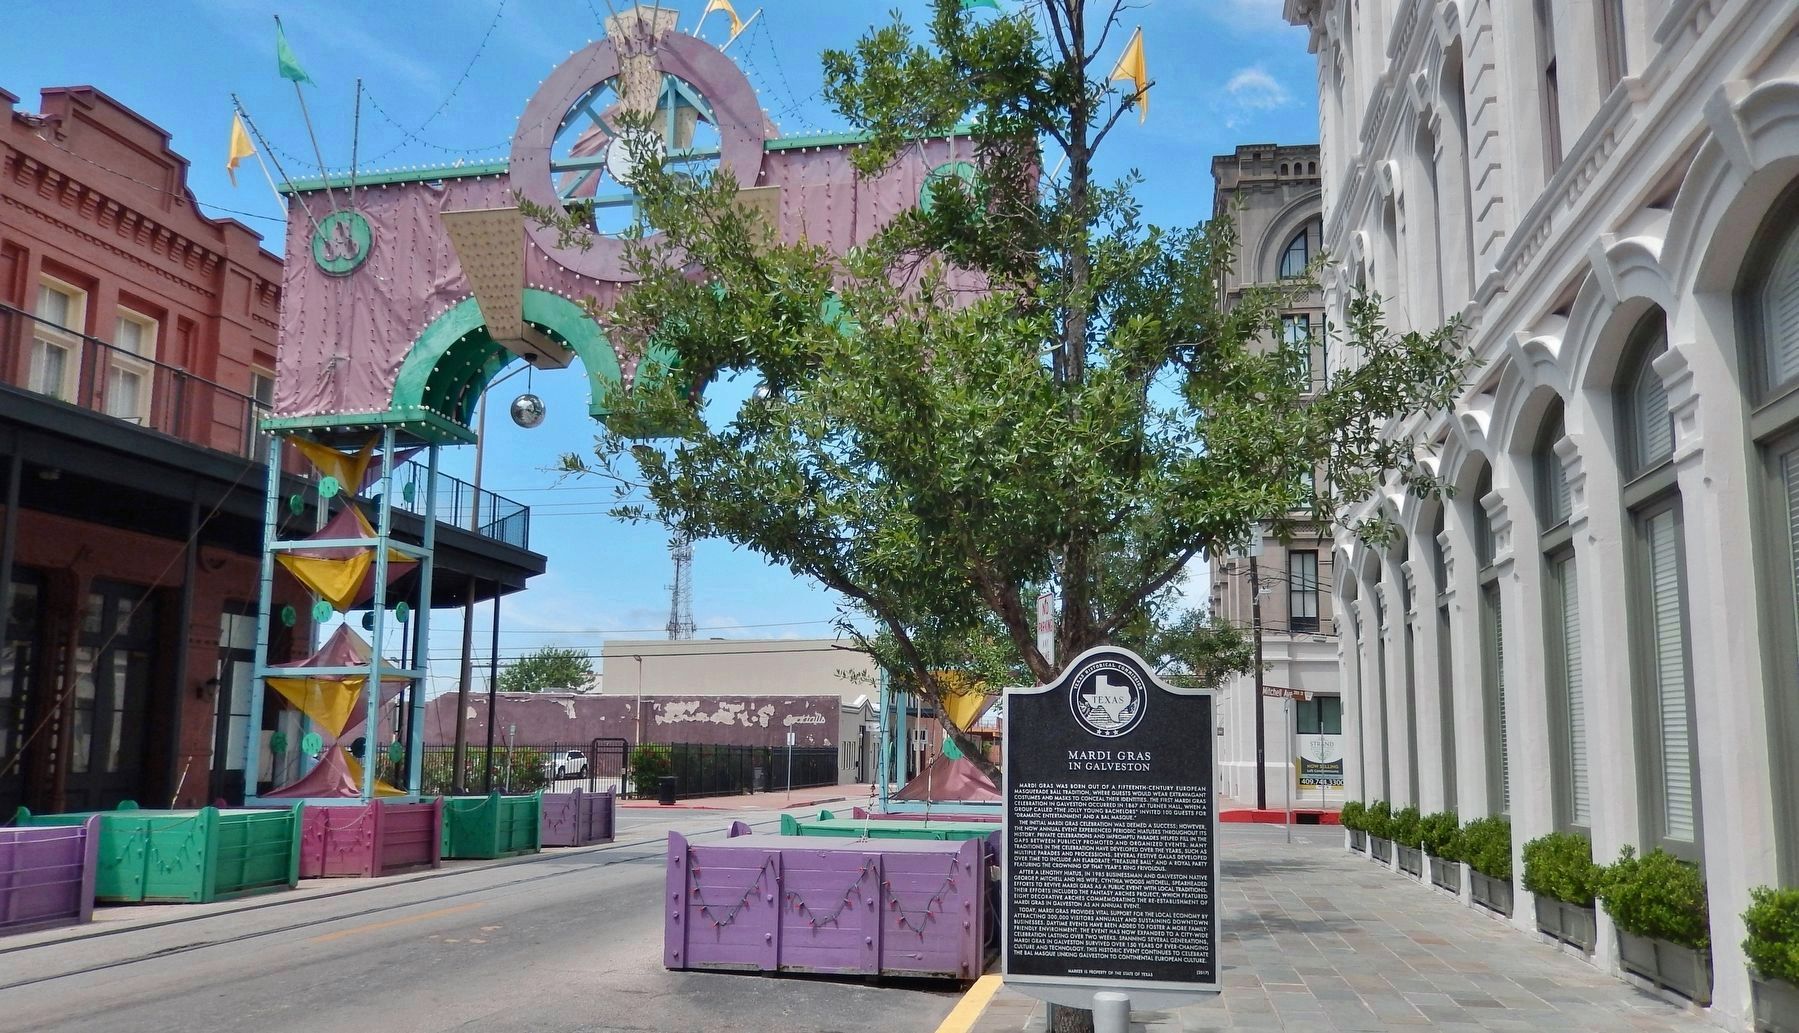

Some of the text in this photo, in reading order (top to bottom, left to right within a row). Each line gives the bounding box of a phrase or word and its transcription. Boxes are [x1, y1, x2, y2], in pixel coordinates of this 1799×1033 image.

[1073, 662, 1143, 690] TEXAS HISTORICAL COMMISSION
[1262, 686, 1283, 697] Mitchell
[1283, 689, 1293, 699] Ave
[1091, 695, 1125, 704] TEXAS
[1068, 750, 1151, 761] MARDI GRAS
[1068, 761, 1151, 772] IN GALVESTON
